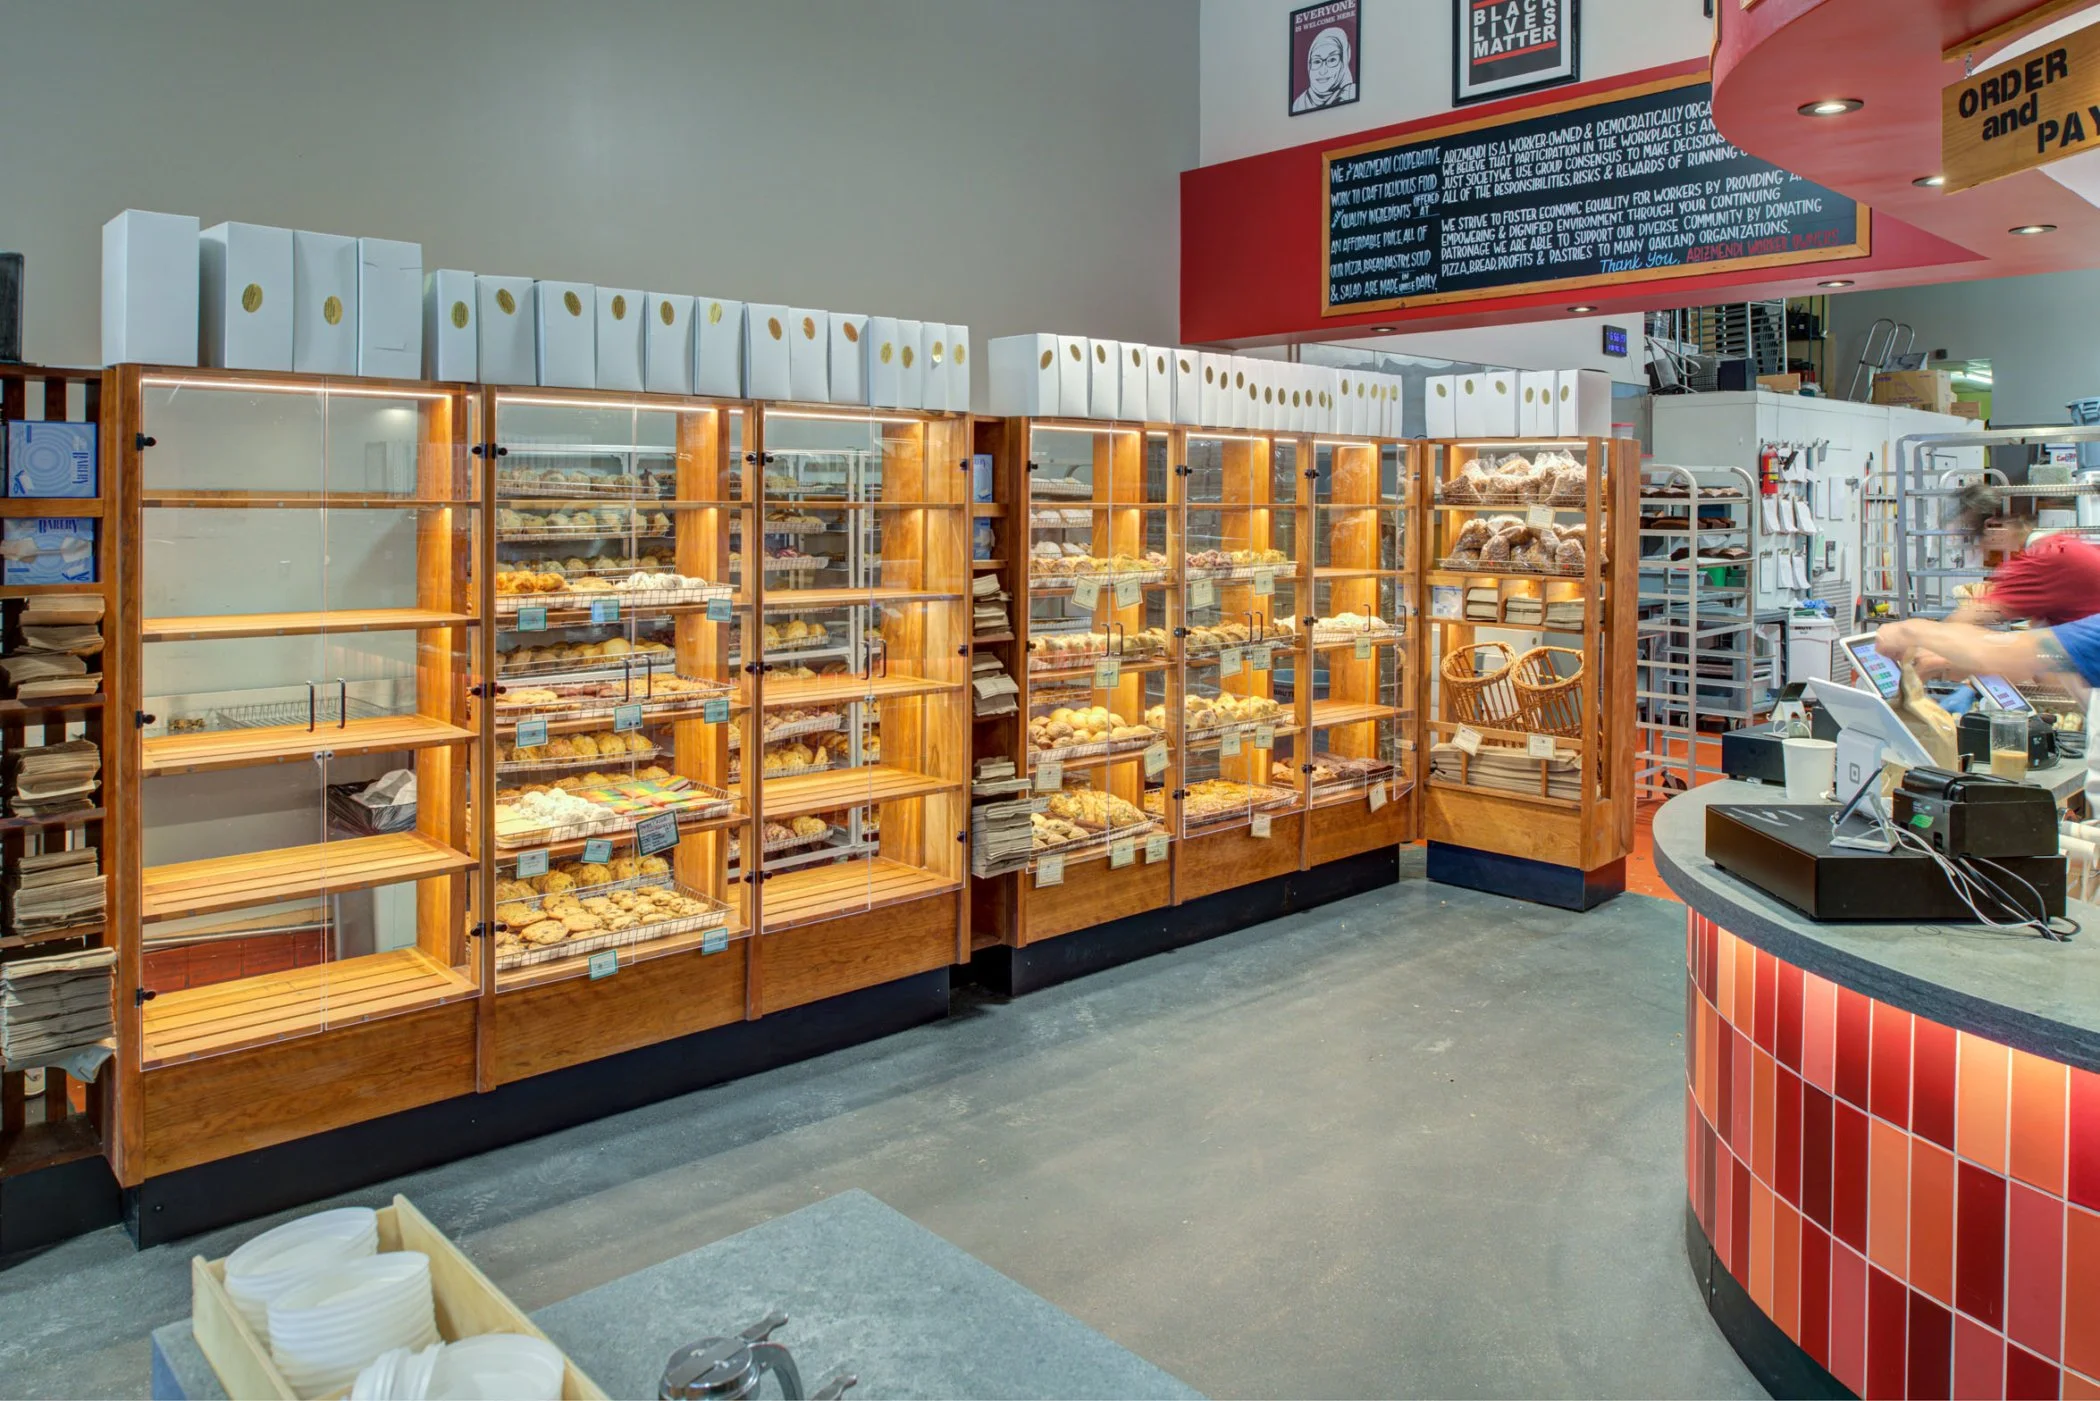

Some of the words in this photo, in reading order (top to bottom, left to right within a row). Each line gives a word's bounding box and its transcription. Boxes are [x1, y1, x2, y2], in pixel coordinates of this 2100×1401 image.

[1295, 0, 1356, 24] EVERYONE
[1303, 16, 1336, 30] WELCOME
[1337, 10, 1356, 20] HERE
[1474, 7, 1556, 42] LIVES
[1474, 24, 1556, 58] MATTER
[1959, 48, 2068, 118] ORDER
[1443, 144, 1486, 164] ARIZMENDI
[1489, 142, 1498, 156] IS
[1500, 141, 1506, 154] A
[1509, 126, 1582, 153] WORKER-OWNED
[1584, 122, 1592, 139] &
[1596, 105, 1683, 137] DEMOCRATICALLY
[1982, 92, 2038, 140] and
[1331, 165, 1344, 183] WE
[1353, 156, 1392, 180] ARIZMENDI
[1393, 146, 1440, 172] COOPERATIVE
[1442, 175, 1463, 190] JUST
[1516, 164, 1533, 178] USE
[1535, 160, 1562, 175] GROUP
[1565, 149, 1622, 170] CONSENSUS
[1627, 147, 1640, 160] TO
[1643, 141, 1670, 158] MAKE
[1443, 164, 1454, 176] WE
[1456, 159, 1486, 173] BELIEVE
[1489, 154, 1512, 169] THAT
[1515, 143, 1580, 164] PARTICIPATION
[1583, 140, 1594, 153] IN
[1598, 136, 1617, 150] THE
[1621, 123, 1682, 147] WORKPLACE
[1685, 121, 1696, 135] IS
[1331, 190, 1350, 207] WORK
[1352, 188, 1360, 204] TO
[1362, 184, 1384, 202] CRAFT
[1384, 177, 1417, 198] DELICIOUS
[1418, 173, 1437, 192] FOOD
[1442, 190, 1458, 204] ALL
[1460, 187, 1472, 201] OF
[1475, 185, 1491, 199] THE
[1604, 165, 1613, 180] &
[1616, 157, 1665, 178] REWARDS
[1668, 154, 1682, 170] OF
[1688, 145, 1738, 167] RUNNING
[1413, 192, 1440, 207] OFFERED
[1420, 205, 1429, 216] AT
[1441, 218, 1456, 232] WE
[1458, 214, 1488, 230] STRIVE
[1491, 213, 1501, 226] TO
[1503, 208, 1537, 225] FOSTER
[1539, 201, 1582, 219] ECONOMIC
[1585, 195, 1629, 213] EQUALITY
[1633, 190, 1651, 205] FOR
[1654, 182, 1702, 202] WORKERS
[1706, 179, 1721, 195] BY
[1726, 170, 1784, 192] PROVIDING
[1441, 229, 1496, 246] EMPOWERING
[1499, 226, 1506, 239] &
[1509, 221, 1553, 238] DIGNIFIED
[1557, 211, 1624, 232] ENVIRONMENT.
[1627, 202, 1674, 220] THROUGH
[1679, 198, 1706, 214] YOUR
[1711, 187, 1780, 209] CONTINUING
[1341, 210, 1368, 229] QUALITY
[1441, 242, 1490, 261] PATRONAGE
[1494, 240, 1507, 254] WE
[1510, 238, 1527, 252] ARE
[1530, 235, 1552, 250] ABLE
[1557, 233, 1570, 247] TO
[1574, 227, 1614, 245] SUPPORT
[1617, 225, 1634, 238] OUR
[1639, 219, 1678, 236] DIVERSE
[1683, 209, 1742, 230] COMMUNITY
[1747, 206, 1761, 222] BY
[1766, 198, 1822, 219] DONATING
[1331, 239, 1342, 254] AN
[1342, 234, 1382, 253] AFFORDABLE
[1403, 228, 1415, 243] ALL
[1417, 225, 1428, 242] OF
[1537, 250, 1545, 265] &
[1550, 245, 1592, 264] PASTRIES
[1598, 243, 1610, 257] TO
[1614, 238, 1644, 256] MANY
[1649, 232, 1695, 251] OAKLAND
[1700, 219, 1791, 243] ORGANIZATIONS.
[1600, 254, 1642, 274] Thank
[1686, 242, 1743, 262] ARIZMENDI
[1748, 236, 1788, 254] WORKER
[1792, 228, 1839, 249] OWNERS
[1330, 263, 1344, 278] OUR
[1411, 249, 1431, 267] SOUP
[1331, 284, 1339, 302] &
[1340, 282, 1362, 300] SALAD
[1364, 280, 1378, 297] ARE
[1380, 278, 1398, 295] MADE
